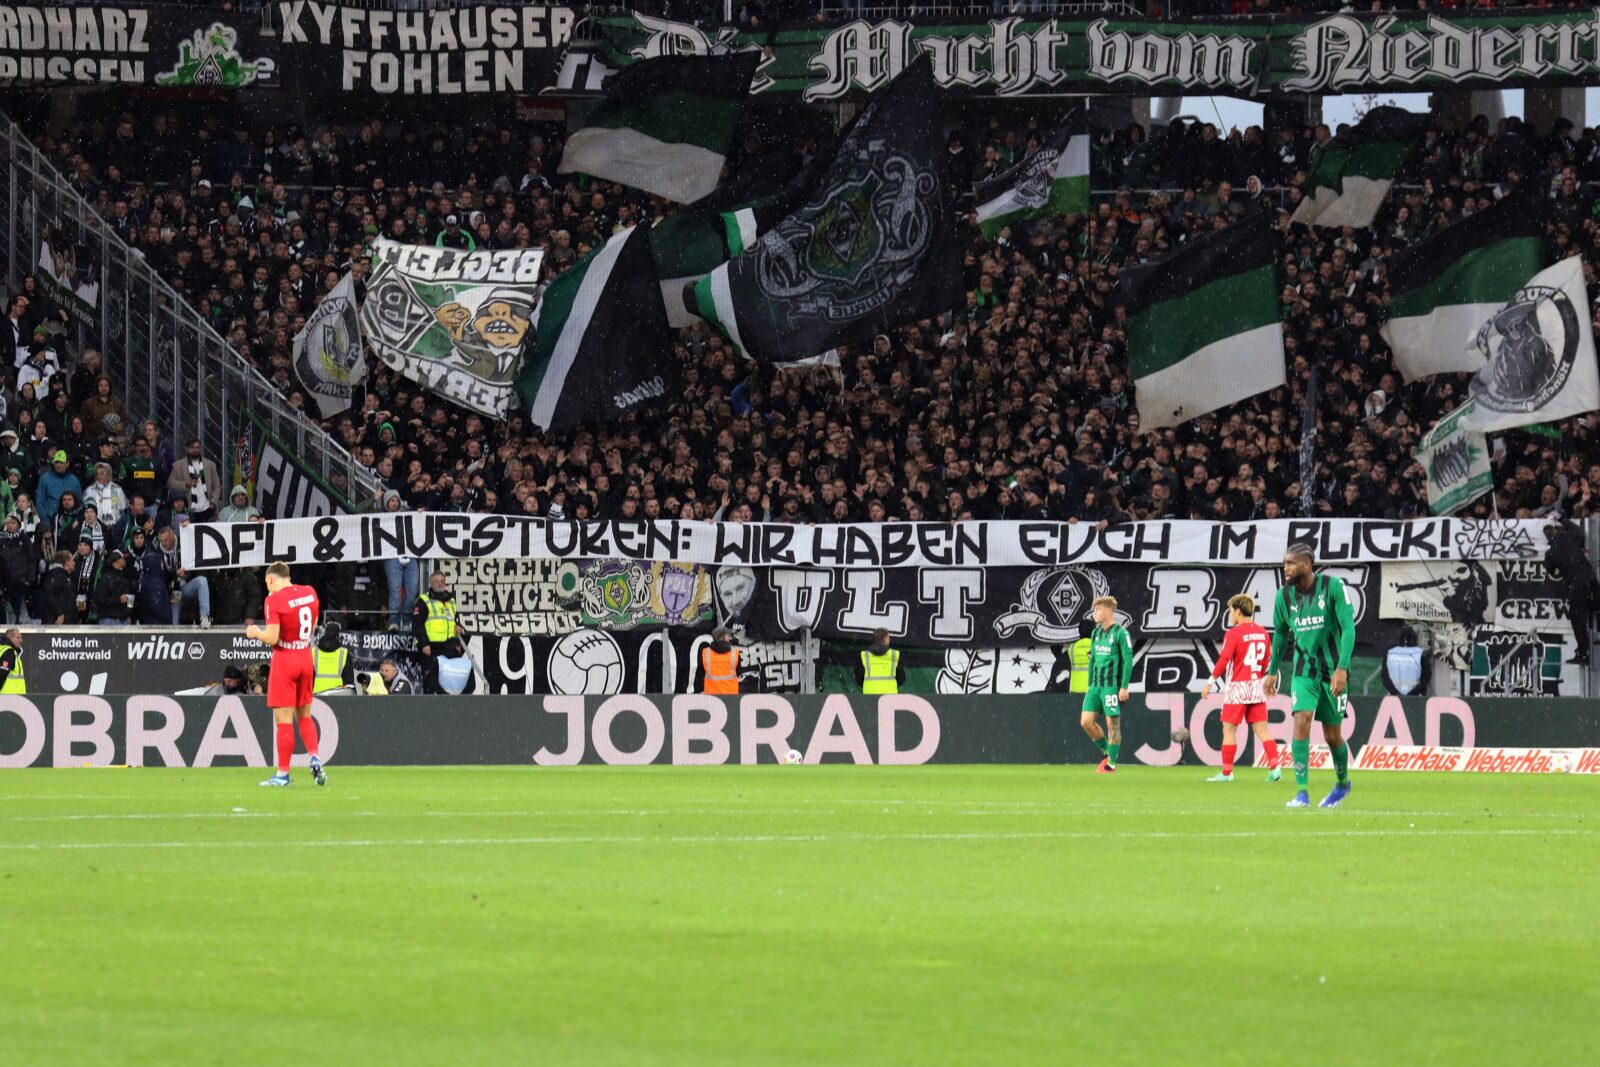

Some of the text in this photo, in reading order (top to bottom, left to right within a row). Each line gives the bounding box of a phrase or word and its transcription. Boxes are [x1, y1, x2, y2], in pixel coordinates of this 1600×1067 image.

[280, 0, 575, 50] KYFFHÄUSER
[803, 17, 1068, 102] Macht
[1087, 17, 1255, 90] vom
[1280, 8, 1600, 93] Niederr
[342, 49, 524, 95] FOHLEN
[194, 515, 1450, 567] DFL & INVESTOREN: WIR HABEN EUCH IM BLICK!
[438, 558, 562, 584] BEGLEIT
[1498, 560, 1563, 582] VIT
[446, 582, 556, 612] ERVICE
[1500, 598, 1571, 620] CREW
[298, 606, 312, 639] 8
[38, 649, 111, 660] Schwarzwald
[51, 637, 98, 648] Made im
[127, 635, 185, 660] wiha
[219, 649, 273, 660] Schwarzw
[232, 637, 262, 648] Made
[1243, 642, 1266, 672] 42
[1105, 694, 1118, 707] 20
[1337, 693, 1348, 713] 13
[533, 693, 941, 765] JOBRAD
[1358, 745, 1461, 771] WeberHaus
[1464, 748, 1551, 773] WeberHau
